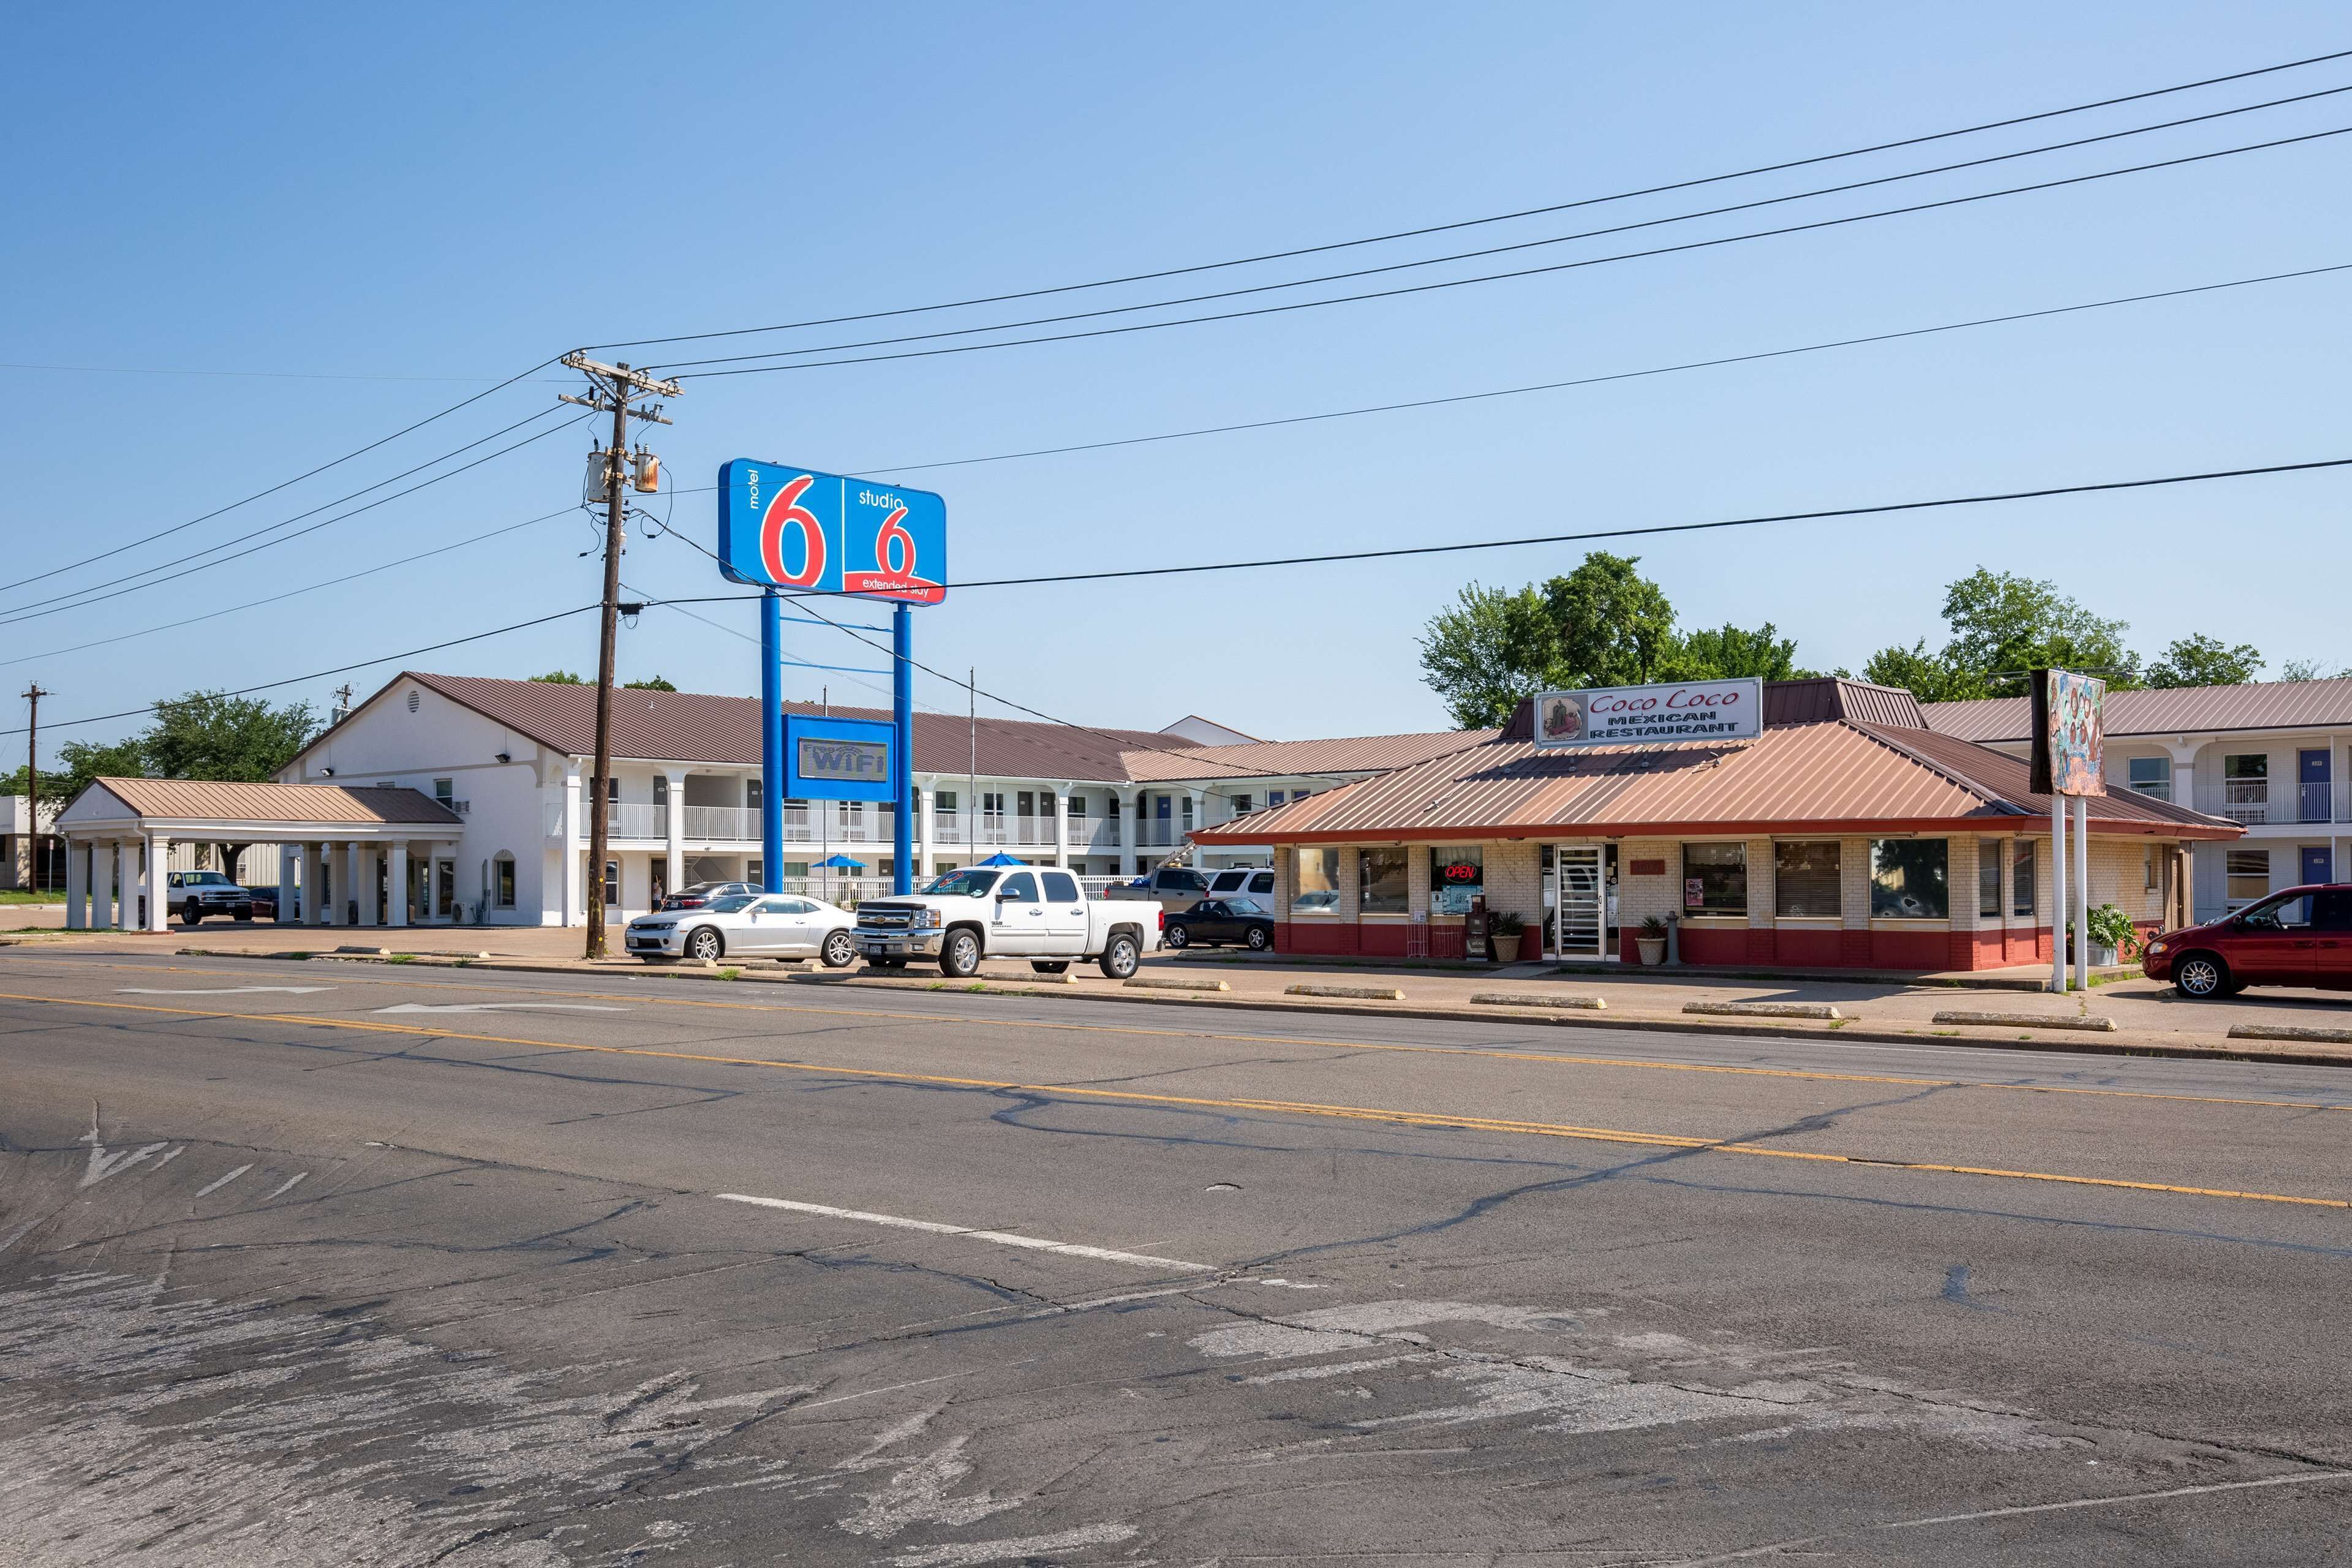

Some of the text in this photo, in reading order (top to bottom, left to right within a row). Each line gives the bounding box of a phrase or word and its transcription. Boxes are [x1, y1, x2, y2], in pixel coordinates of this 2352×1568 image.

[748, 469, 759, 509] motel
[859, 489, 903, 510] studio
[760, 474, 826, 587] 6
[875, 507, 916, 576] 6
[862, 578, 929, 598] extended stay
[1589, 689, 1740, 714] Coco Loco
[1608, 711, 1716, 726] MEXICAN
[1589, 722, 1739, 739] RESTAURANT
[1446, 865, 1475, 878] OPEN
